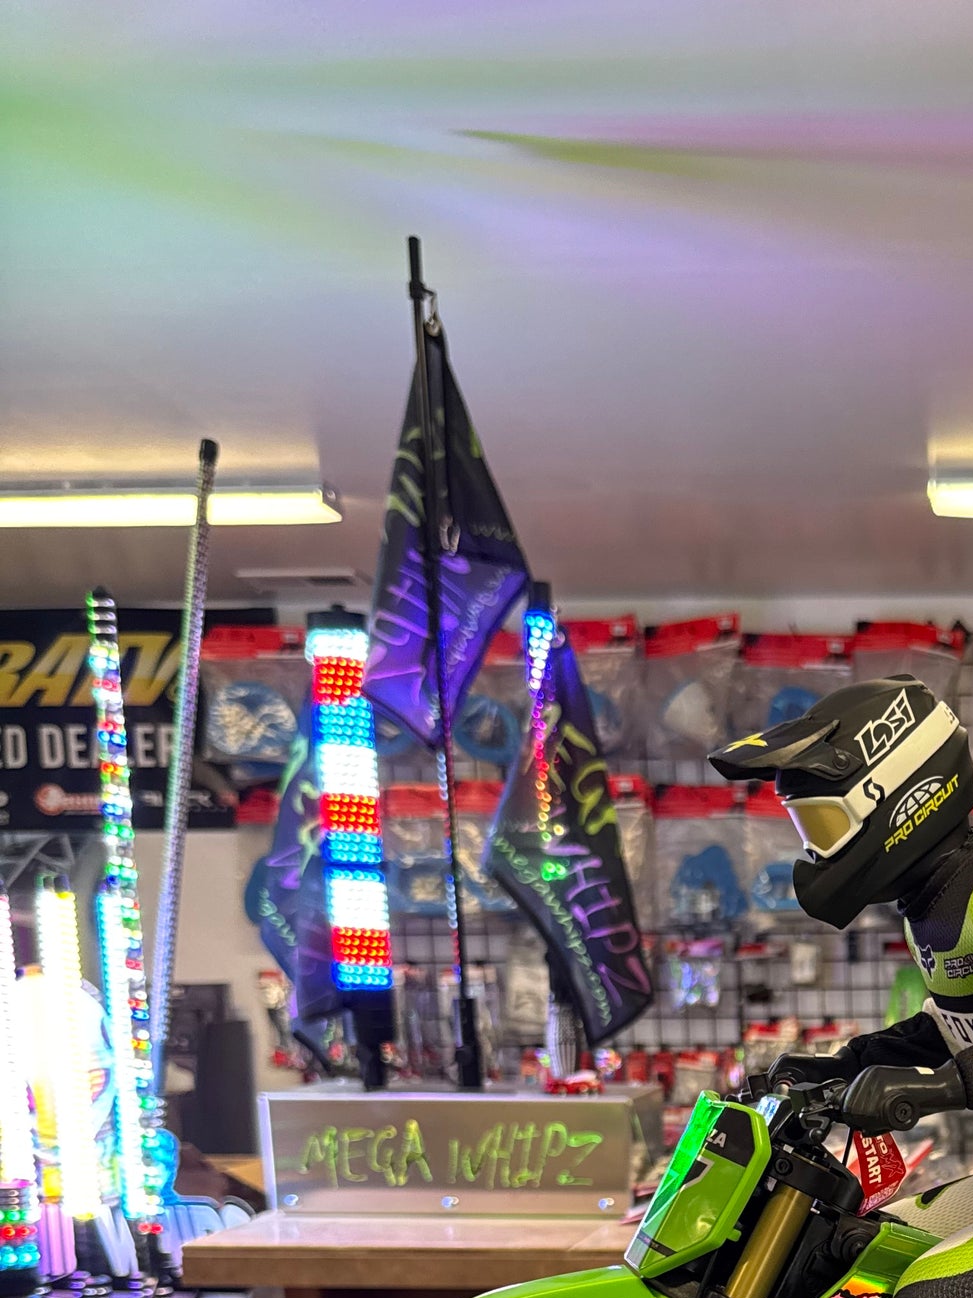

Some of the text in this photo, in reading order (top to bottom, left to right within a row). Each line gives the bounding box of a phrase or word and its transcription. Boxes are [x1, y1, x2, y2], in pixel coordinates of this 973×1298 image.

[884, 773, 960, 853] PRO CIRCUIT
[944, 957, 964, 969] PRO
[300, 1118, 434, 1190] MEGA
